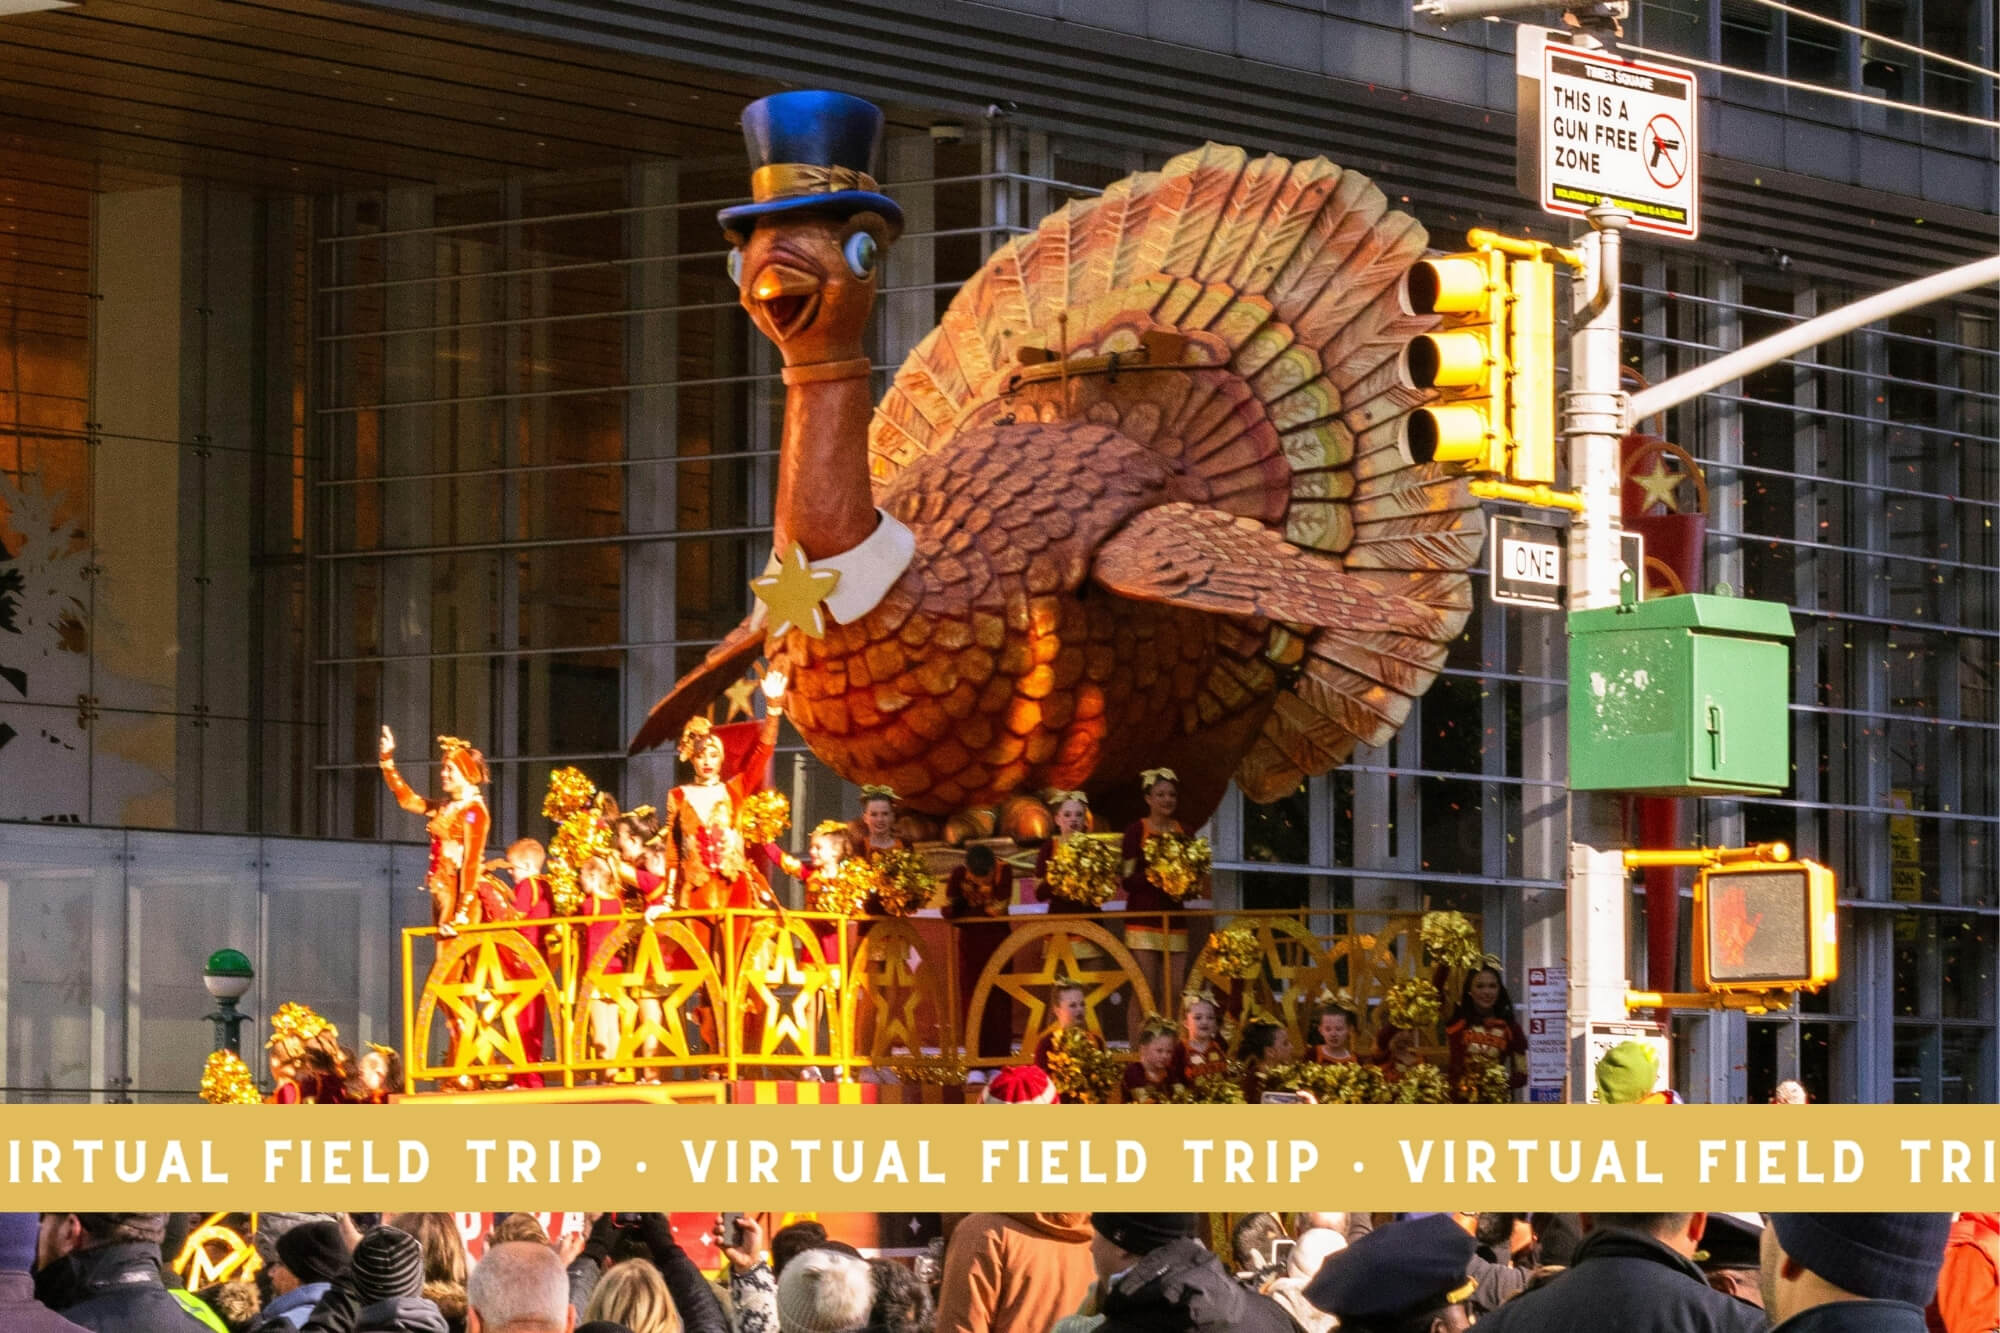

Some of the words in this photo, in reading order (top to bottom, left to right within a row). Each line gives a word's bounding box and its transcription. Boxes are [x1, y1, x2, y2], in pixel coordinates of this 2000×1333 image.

[1584, 64, 1614, 83] TIMES
[1553, 86, 1591, 113] THIS
[1597, 96, 1612, 118] IS
[1618, 100, 1629, 121] A
[1553, 116, 1588, 143] GUN
[1595, 125, 1637, 152] FREE
[1555, 146, 1600, 174] ZONE
[1515, 546, 1554, 580] ONE
